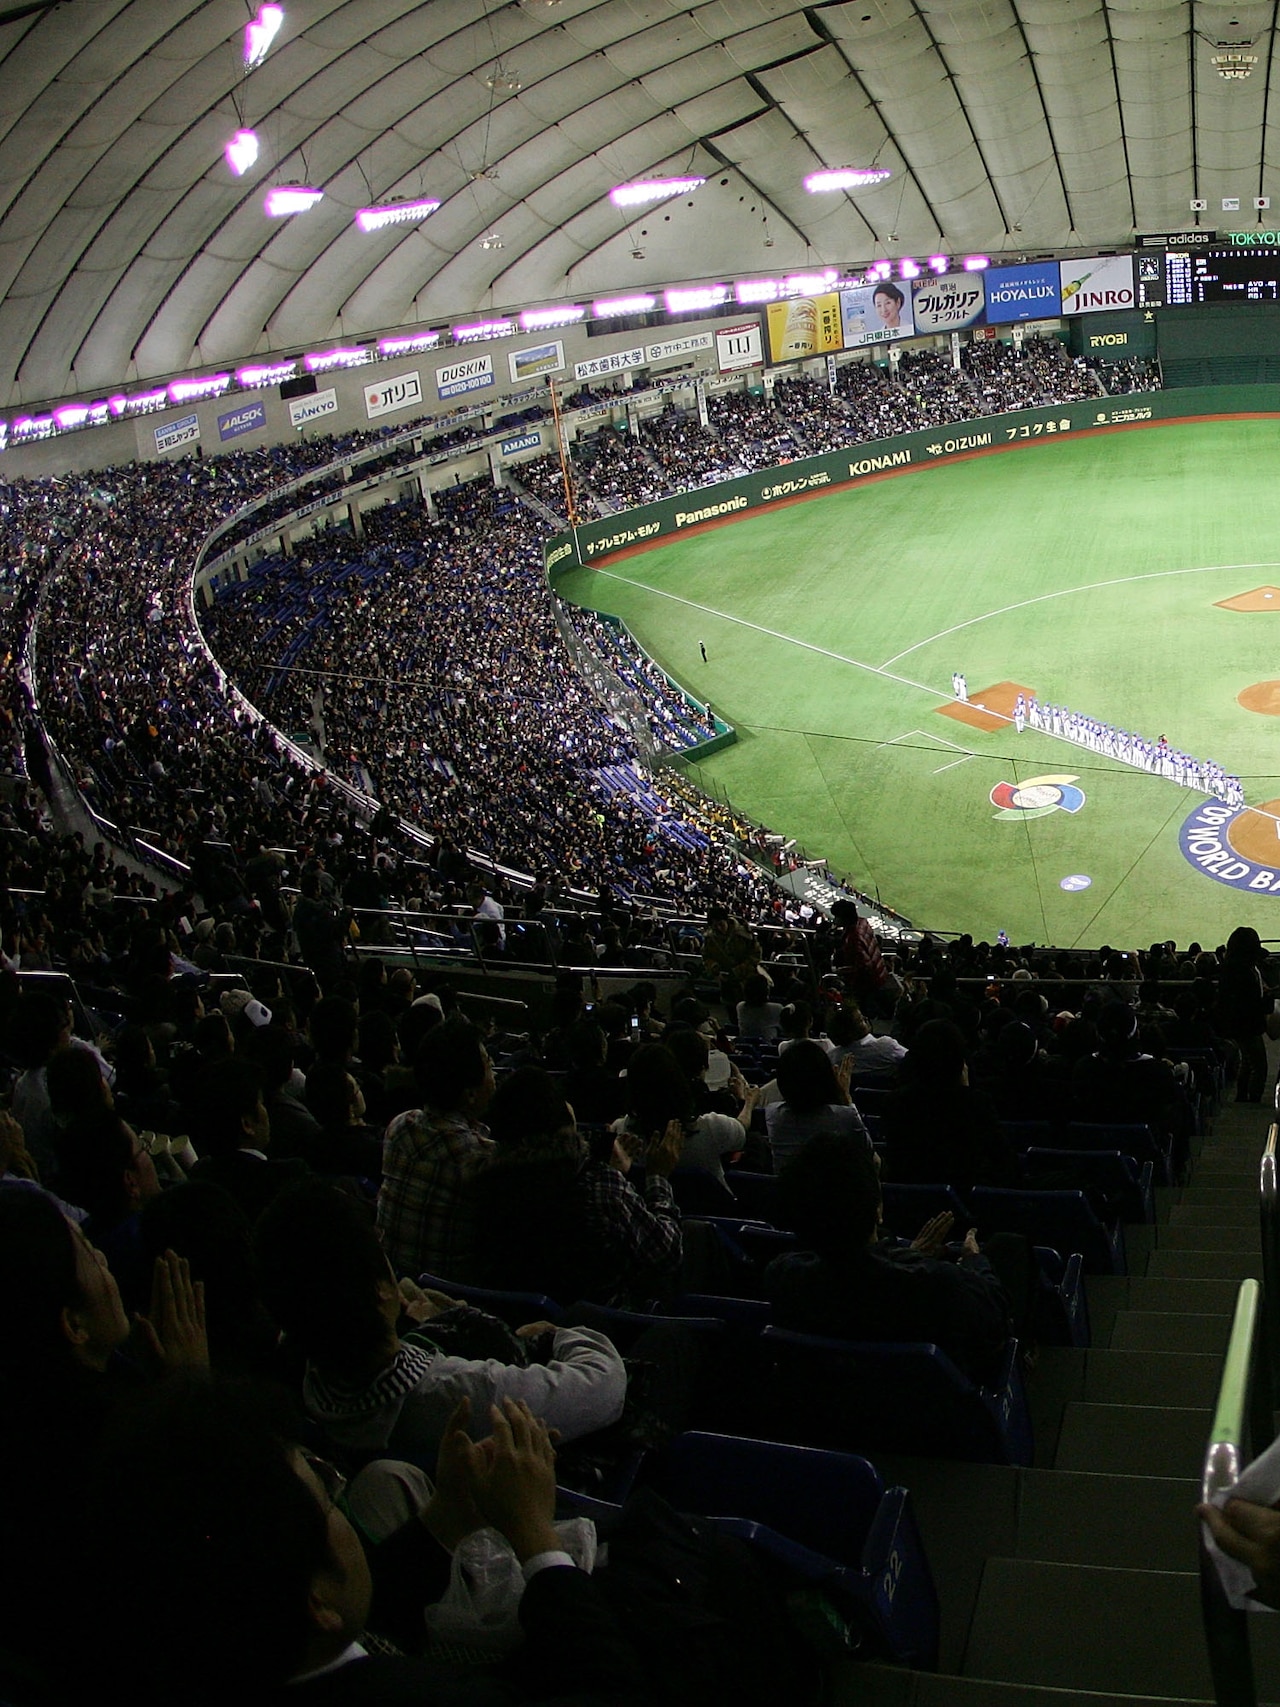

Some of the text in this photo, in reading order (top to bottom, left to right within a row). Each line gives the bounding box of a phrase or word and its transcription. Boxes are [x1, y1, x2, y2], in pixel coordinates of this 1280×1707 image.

[1168, 233, 1209, 244] adidas
[1229, 232, 1275, 245] TOKYO
[940, 282, 957, 292] 明治
[990, 286, 1055, 304] HOYALUX
[918, 290, 980, 314] ブルガリア
[1074, 289, 1134, 312] JINRO
[822, 310, 832, 345] 一番搾り
[931, 310, 970, 324] ヨーグルト
[858, 328, 901, 345] JR東日本
[1090, 333, 1128, 347] RYOBI
[441, 359, 487, 383] DUSKIN
[577, 350, 643, 378] 松本歯科大学
[381, 379, 419, 407] オリコ
[229, 407, 263, 428] ALSOK
[293, 401, 335, 422] SANKYO
[1006, 418, 1072, 441] フコク生命
[503, 434, 540, 453] AMANO
[944, 432, 992, 453] OIZUMI
[848, 450, 912, 477] KONAMI
[772, 477, 808, 497] ホクレン
[675, 496, 748, 527] Panasonic
[586, 521, 661, 555] ザ・プレミアム・モルツ
[1187, 826, 1250, 880] WORLD
[883, 1550, 903, 1603] 22
